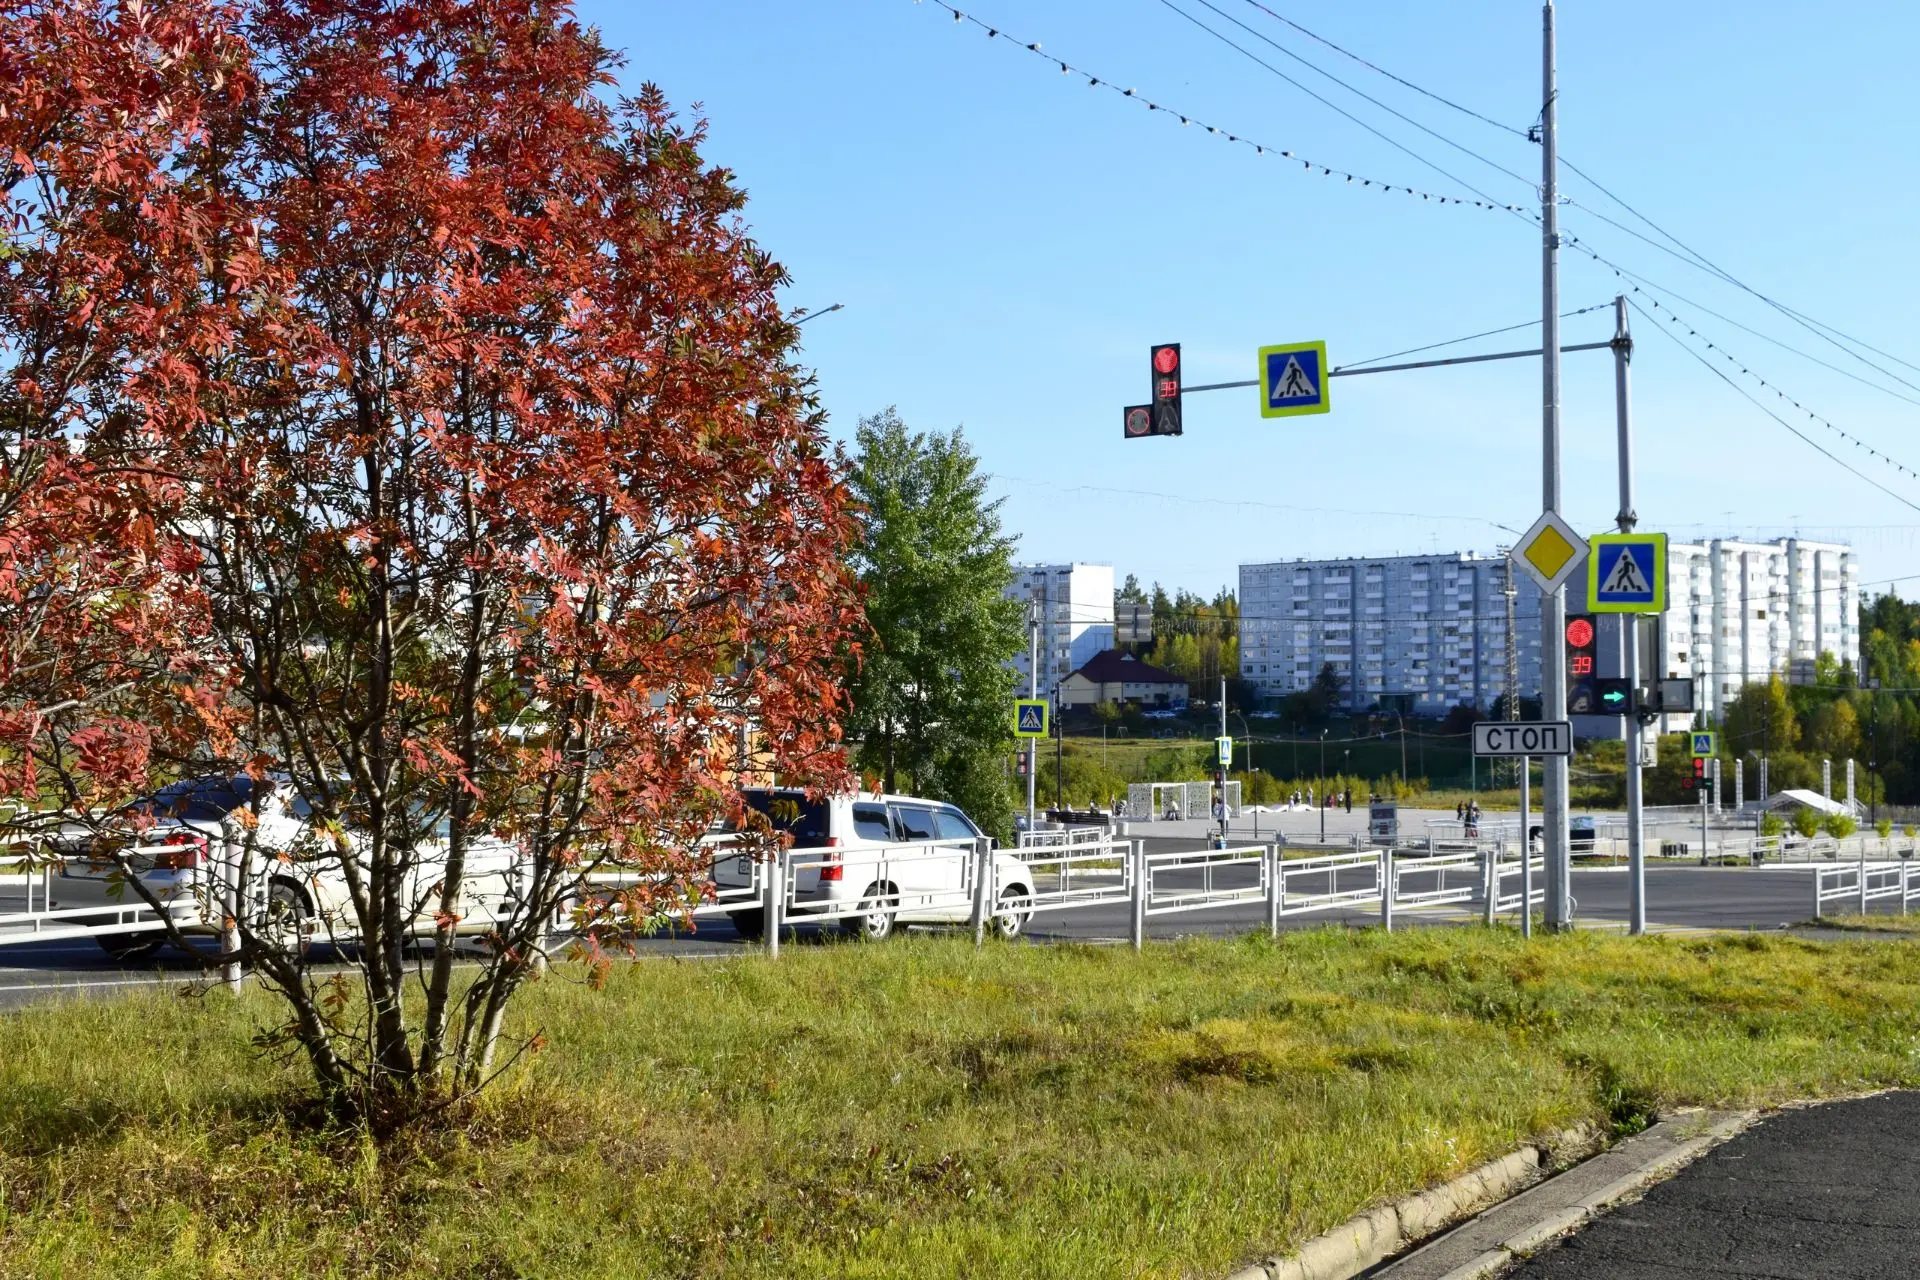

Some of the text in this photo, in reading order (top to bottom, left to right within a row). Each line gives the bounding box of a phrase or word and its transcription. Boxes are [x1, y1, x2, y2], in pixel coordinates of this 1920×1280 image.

[1159, 381, 1177, 397] 39
[1571, 656, 1592, 674] 39
[1486, 727, 1557, 750] СТОП
